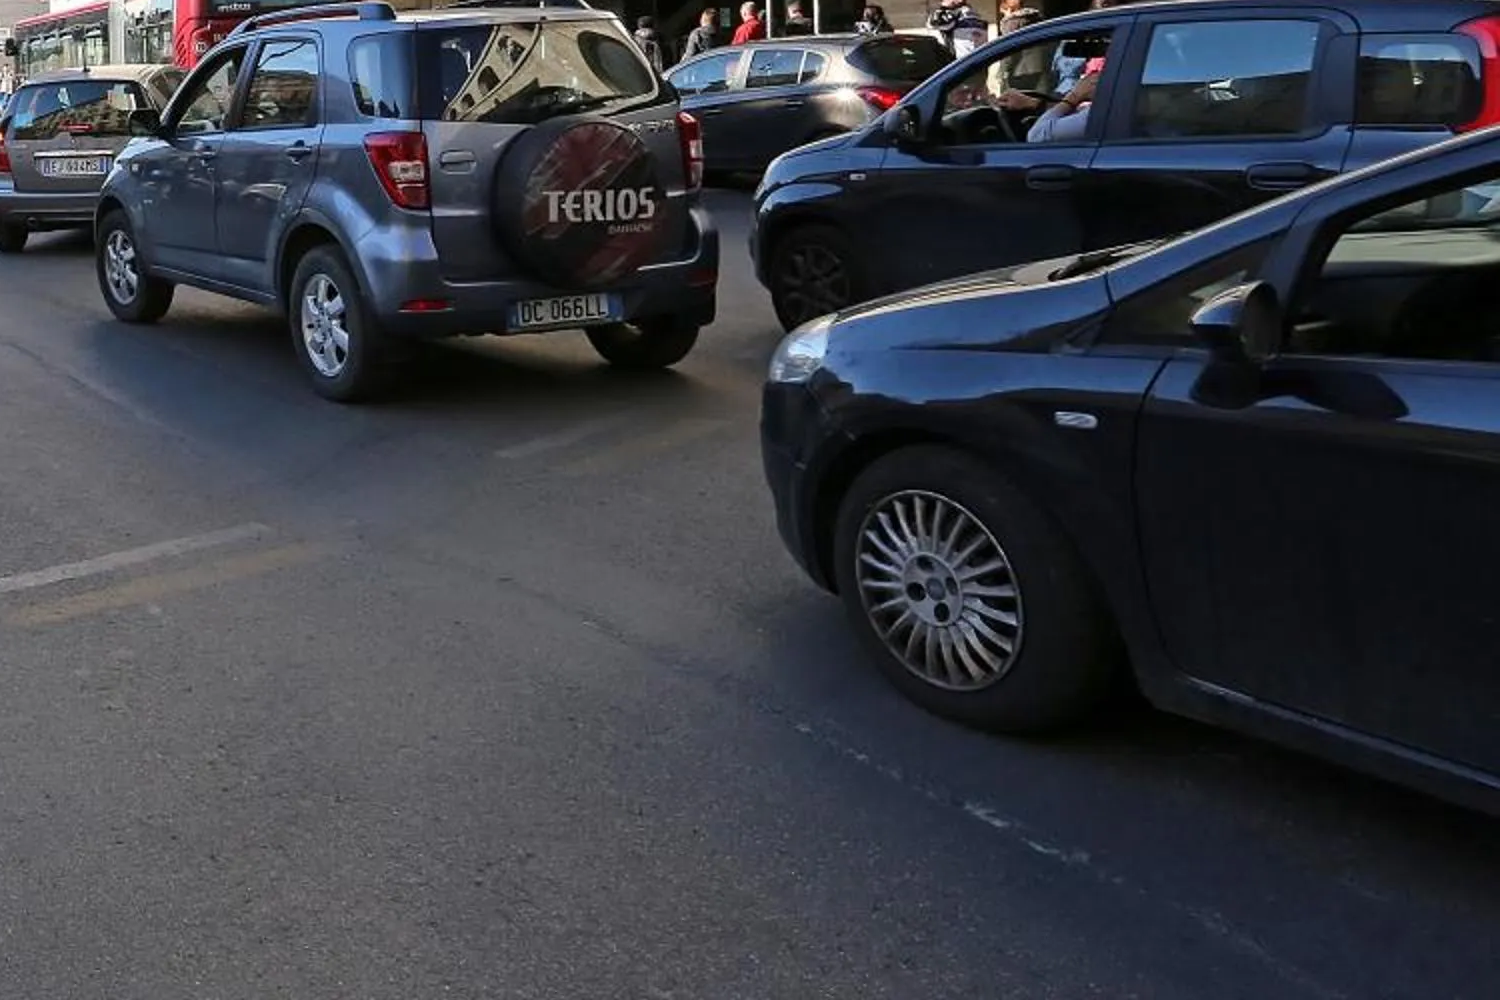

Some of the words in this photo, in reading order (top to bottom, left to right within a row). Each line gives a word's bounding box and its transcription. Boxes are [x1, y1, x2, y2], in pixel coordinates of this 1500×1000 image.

[543, 187, 656, 222] TERIOS
[521, 302, 543, 324] DC
[550, 295, 609, 320] 066LL
